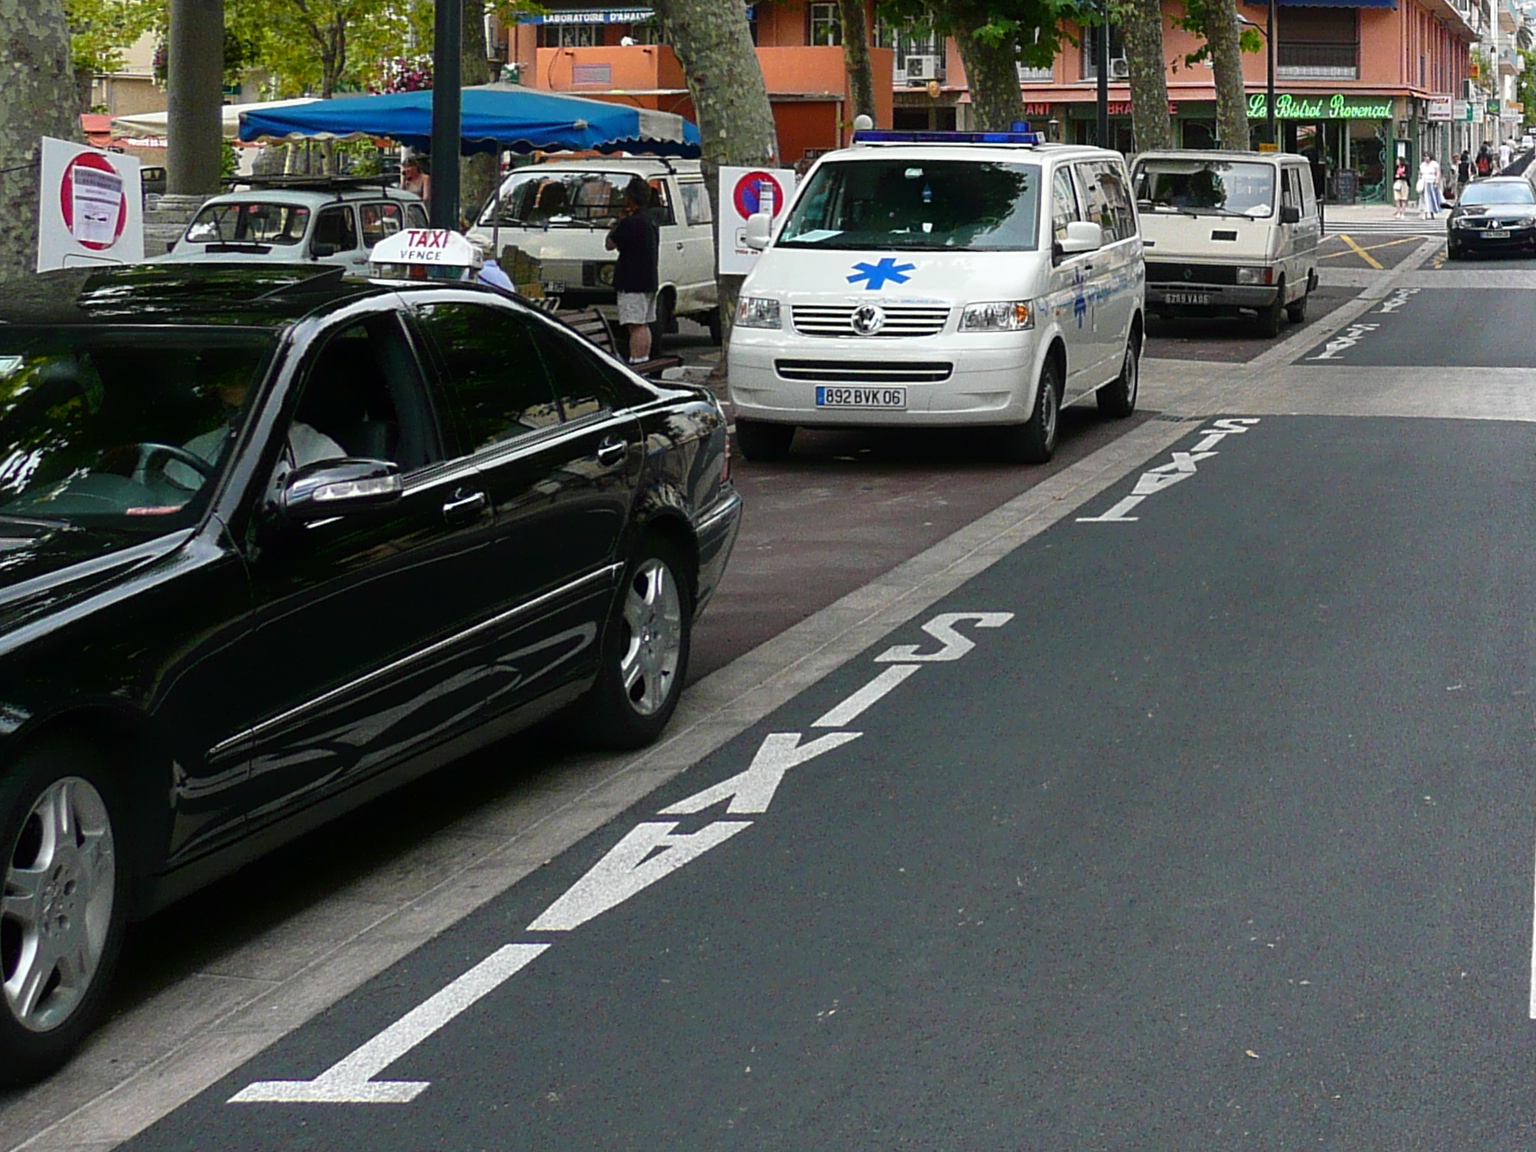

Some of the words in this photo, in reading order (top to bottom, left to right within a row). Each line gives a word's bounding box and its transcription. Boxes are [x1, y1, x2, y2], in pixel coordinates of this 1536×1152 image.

[543, 13, 604, 23] LABORATOIRE
[1246, 94, 1268, 117] Le
[1275, 94, 1323, 118] Bistrot
[1329, 93, 1393, 119] Provençal
[407, 230, 449, 248] TAXI
[400, 250, 442, 261] VENCE
[826, 389, 852, 404] 892
[854, 390, 880, 404] BVK
[883, 390, 900, 404] 06
[1075, 418, 1261, 522] TAXIS
[226, 612, 1015, 1102] TAXIS
